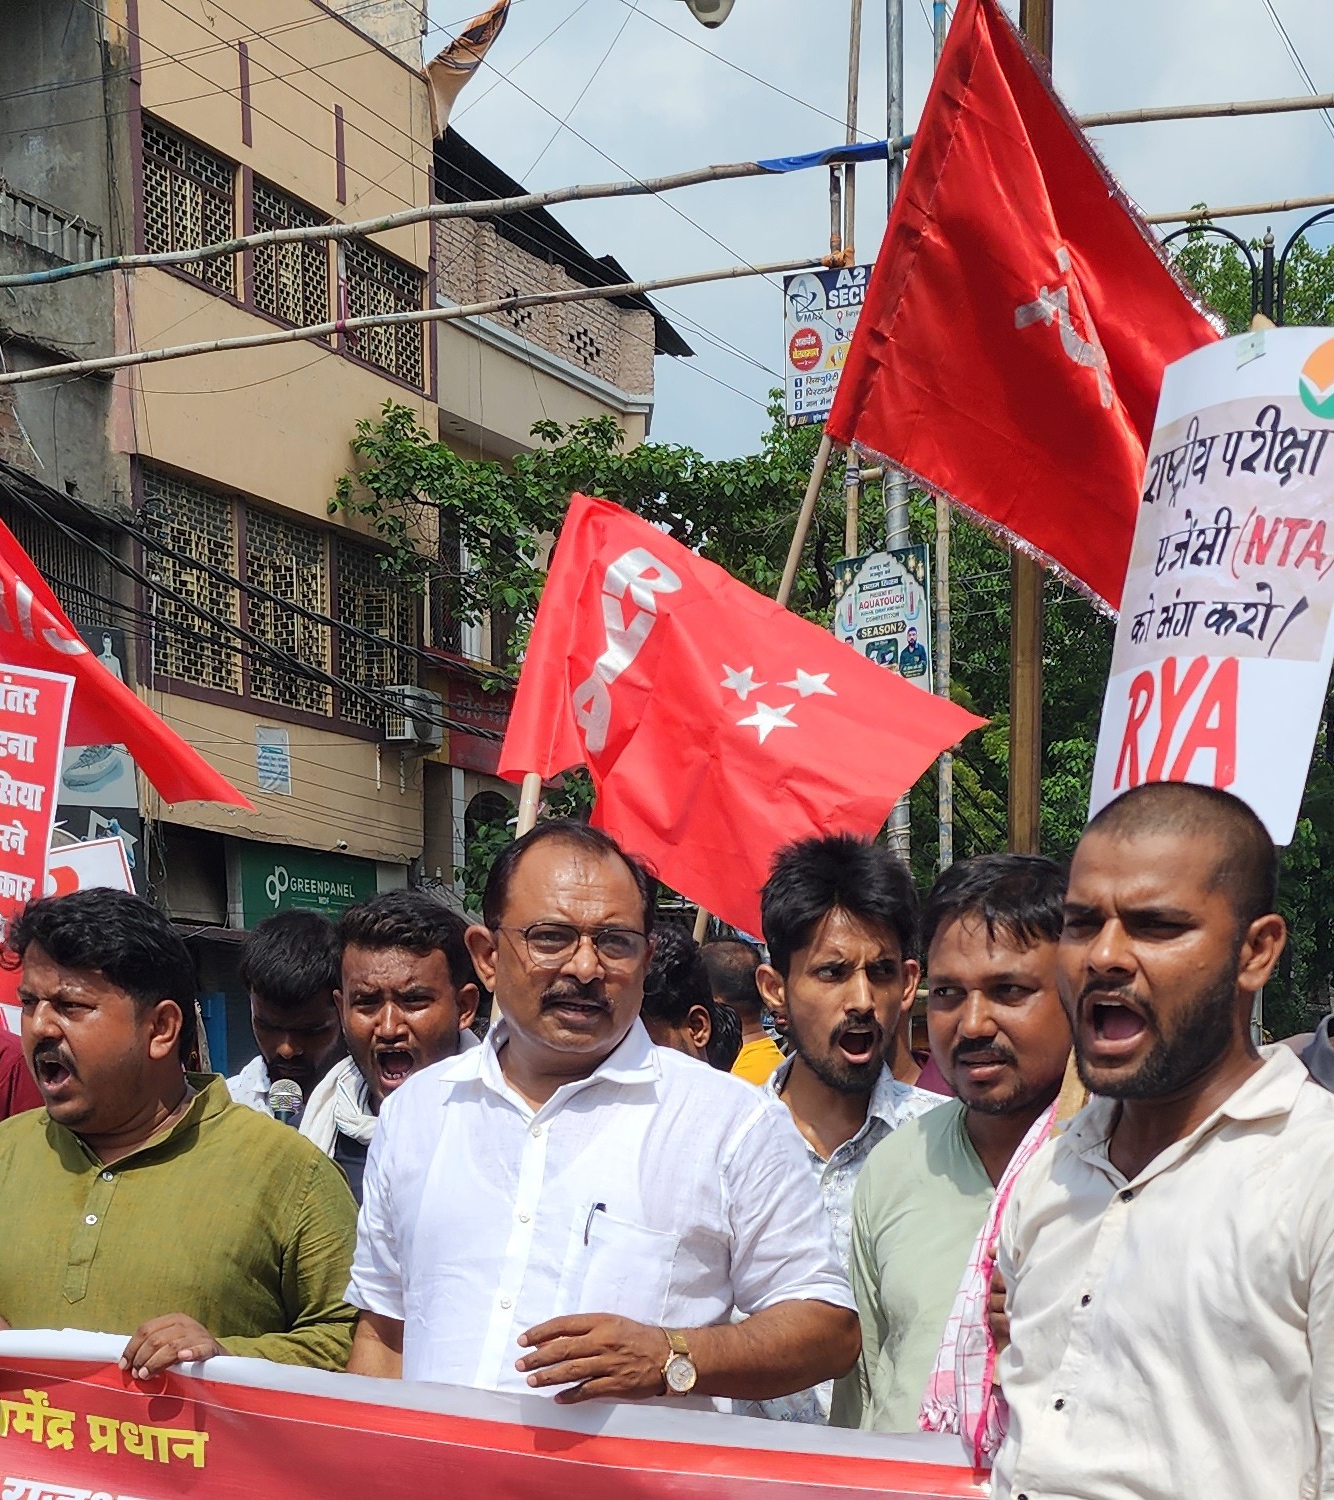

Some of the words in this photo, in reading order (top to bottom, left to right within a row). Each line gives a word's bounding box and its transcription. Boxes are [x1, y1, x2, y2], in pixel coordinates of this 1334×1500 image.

[1155, 506, 1240, 577] एजेंसी
[858, 594, 905, 611] AQUATOUCH
[1131, 593, 1155, 645] को
[573, 546, 683, 758] RYA
[861, 624, 898, 639] SEASON
[1113, 654, 1240, 791] RYA
[290, 877, 355, 898] GREENPANEL
[86, 1414, 210, 1468] प्रधान
